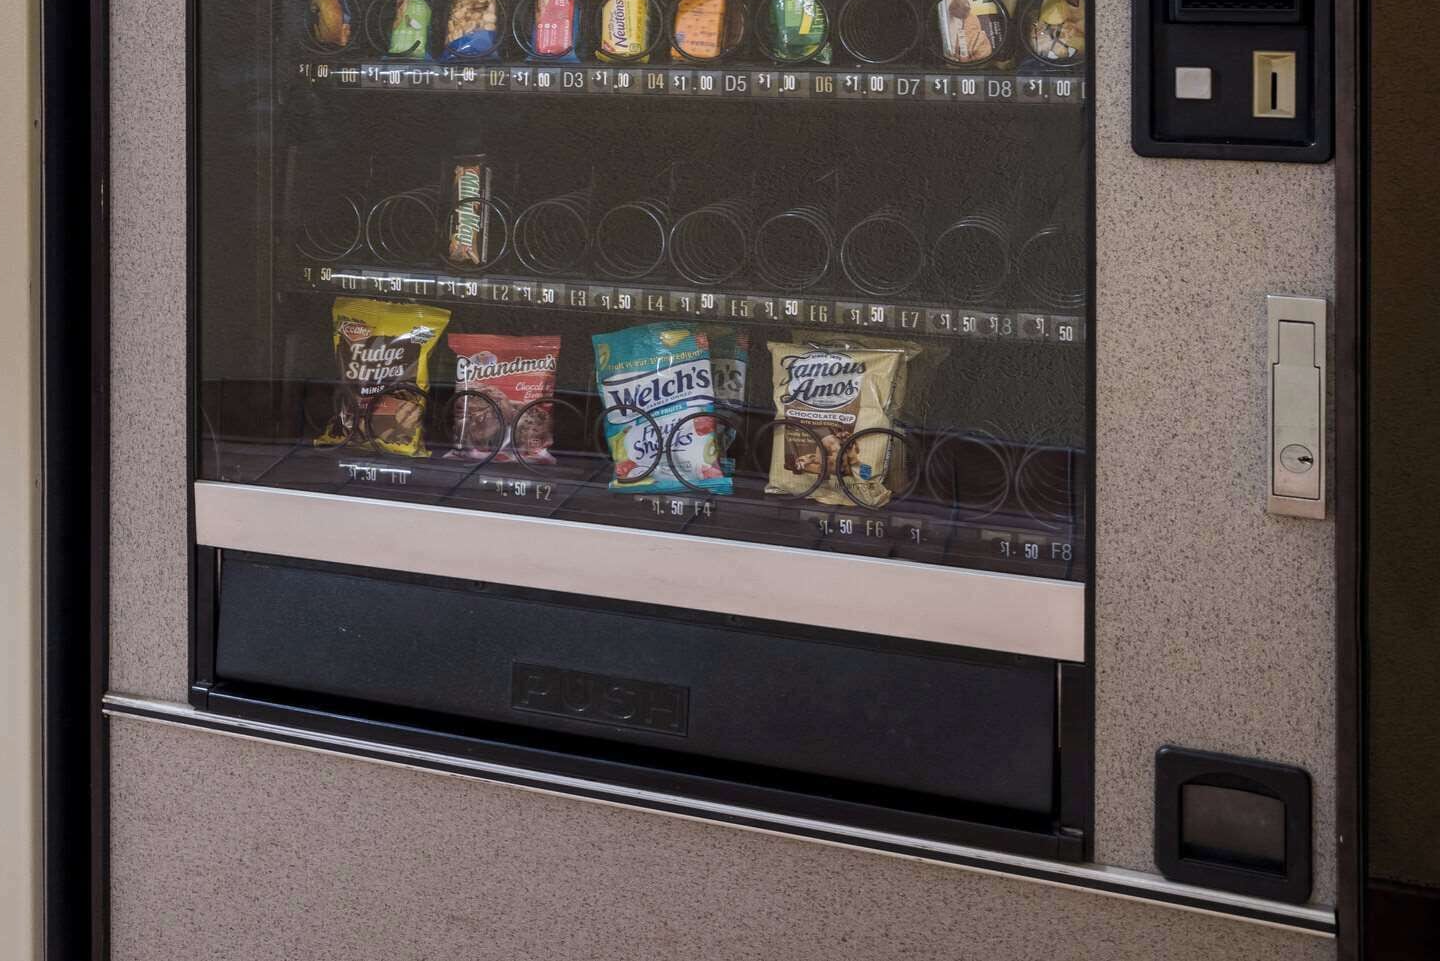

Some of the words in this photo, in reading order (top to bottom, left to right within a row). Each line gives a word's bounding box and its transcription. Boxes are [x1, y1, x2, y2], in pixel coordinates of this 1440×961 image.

[615, 0, 628, 48] Newtons
[413, 70, 430, 84] D1
[564, 72, 584, 88] D3
[726, 76, 746, 91] D5
[815, 76, 833, 93] D6
[846, 76, 884, 93] $1.00
[897, 78, 921, 95] D7
[935, 80, 976, 96] $1.00
[988, 81, 1012, 96] D8
[1029, 81, 1071, 98] $1.00
[493, 285, 508, 301] E2
[570, 290, 586, 306] E3
[602, 294, 631, 310] $1.50
[648, 295, 664, 311] E4
[681, 294, 713, 315] $1.50
[731, 299, 748, 317] E5
[765, 300, 798, 320] $1.50
[810, 304, 827, 322] E6
[850, 307, 884, 326] $1.50
[902, 311, 919, 328] E7
[940, 313, 976, 332] $1.50
[350, 343, 404, 366] Fudge
[346, 361, 404, 385] Stripes
[456, 356, 557, 383] Grandma's
[780, 354, 865, 386] Famous
[609, 366, 710, 417] Welch's
[780, 378, 857, 405] Amos
[789, 410, 837, 420] CHOCOLATE
[536, 485, 552, 501] F2
[694, 501, 711, 516] F4
[866, 521, 884, 537] F6
[1052, 543, 1072, 561] F8
